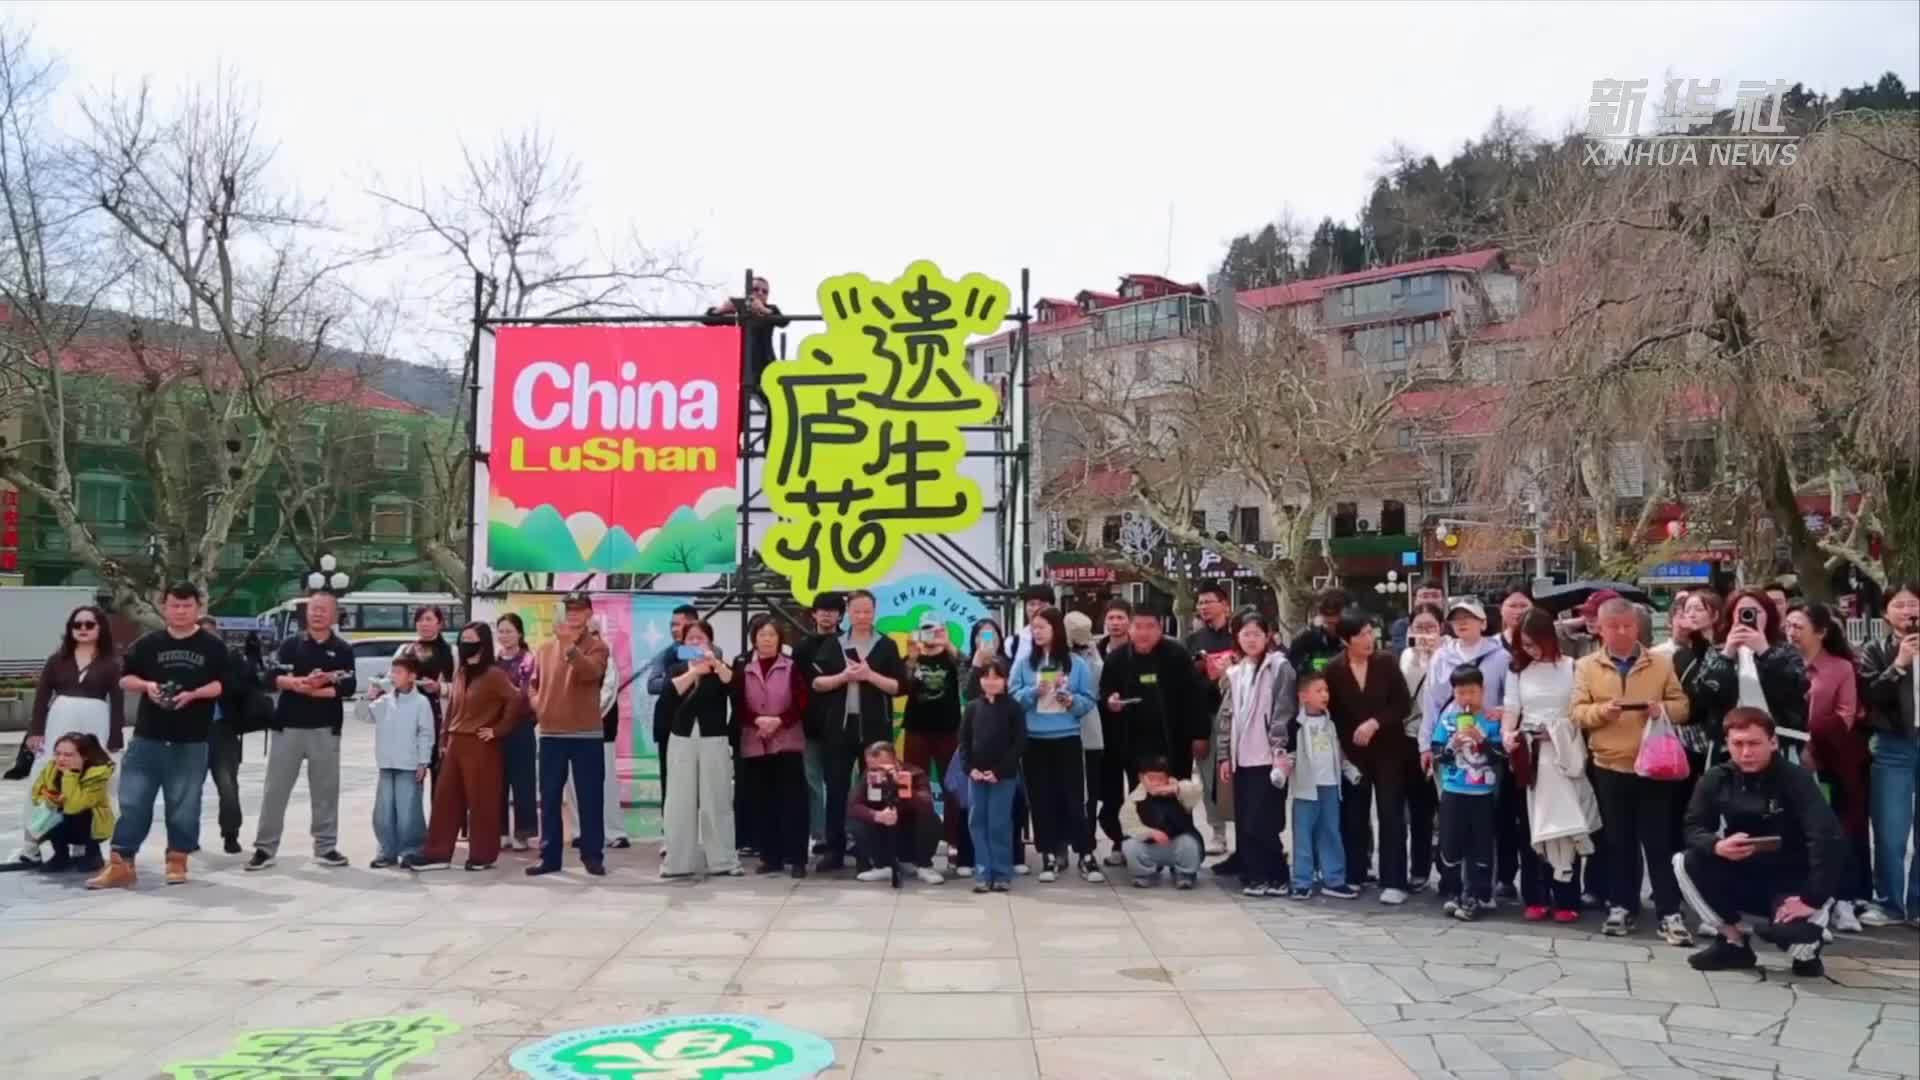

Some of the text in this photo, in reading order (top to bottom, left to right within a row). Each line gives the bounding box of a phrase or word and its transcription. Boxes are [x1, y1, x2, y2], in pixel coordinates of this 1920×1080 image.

[513, 361, 719, 430] China
[510, 436, 716, 472] LuShan
[892, 585, 938, 607] CHINA
